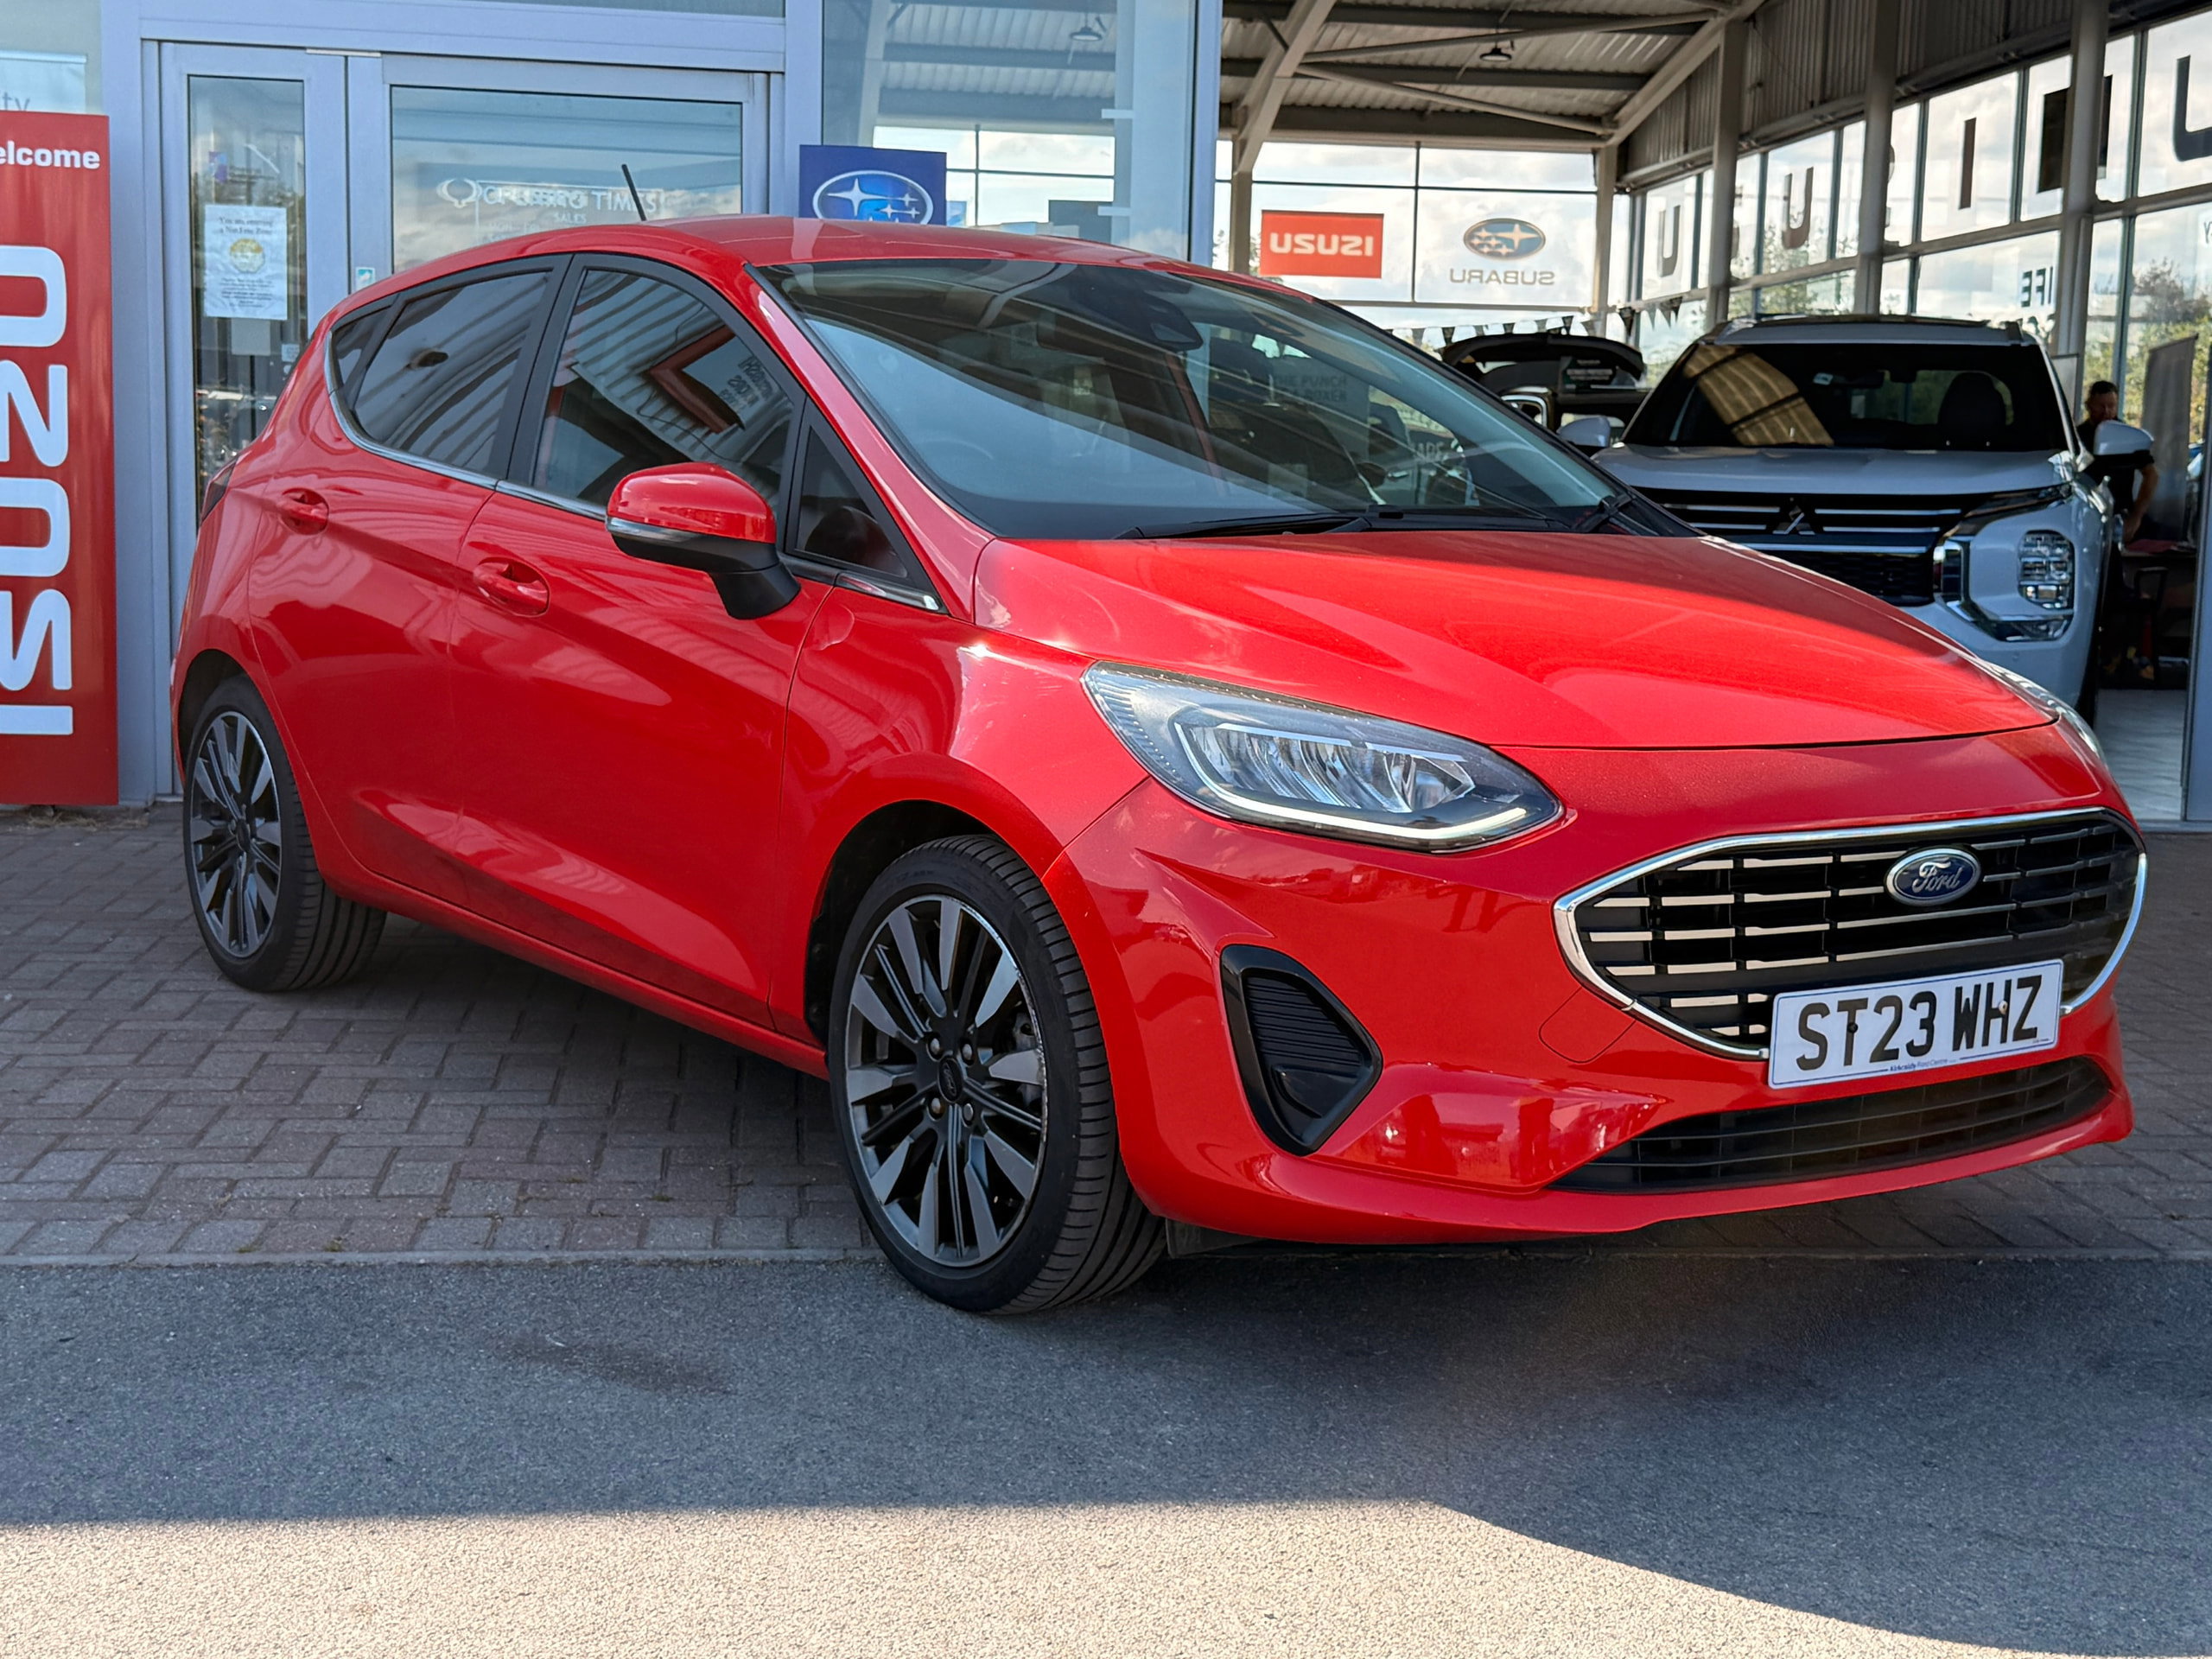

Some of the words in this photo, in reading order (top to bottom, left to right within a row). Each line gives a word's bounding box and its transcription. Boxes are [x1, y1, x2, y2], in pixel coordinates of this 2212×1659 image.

[0, 245, 73, 735] ISUZU
[1911, 861, 1966, 893] Ford
[1796, 990, 1937, 1071] ST23
[1952, 975, 2043, 1052] WHZ
